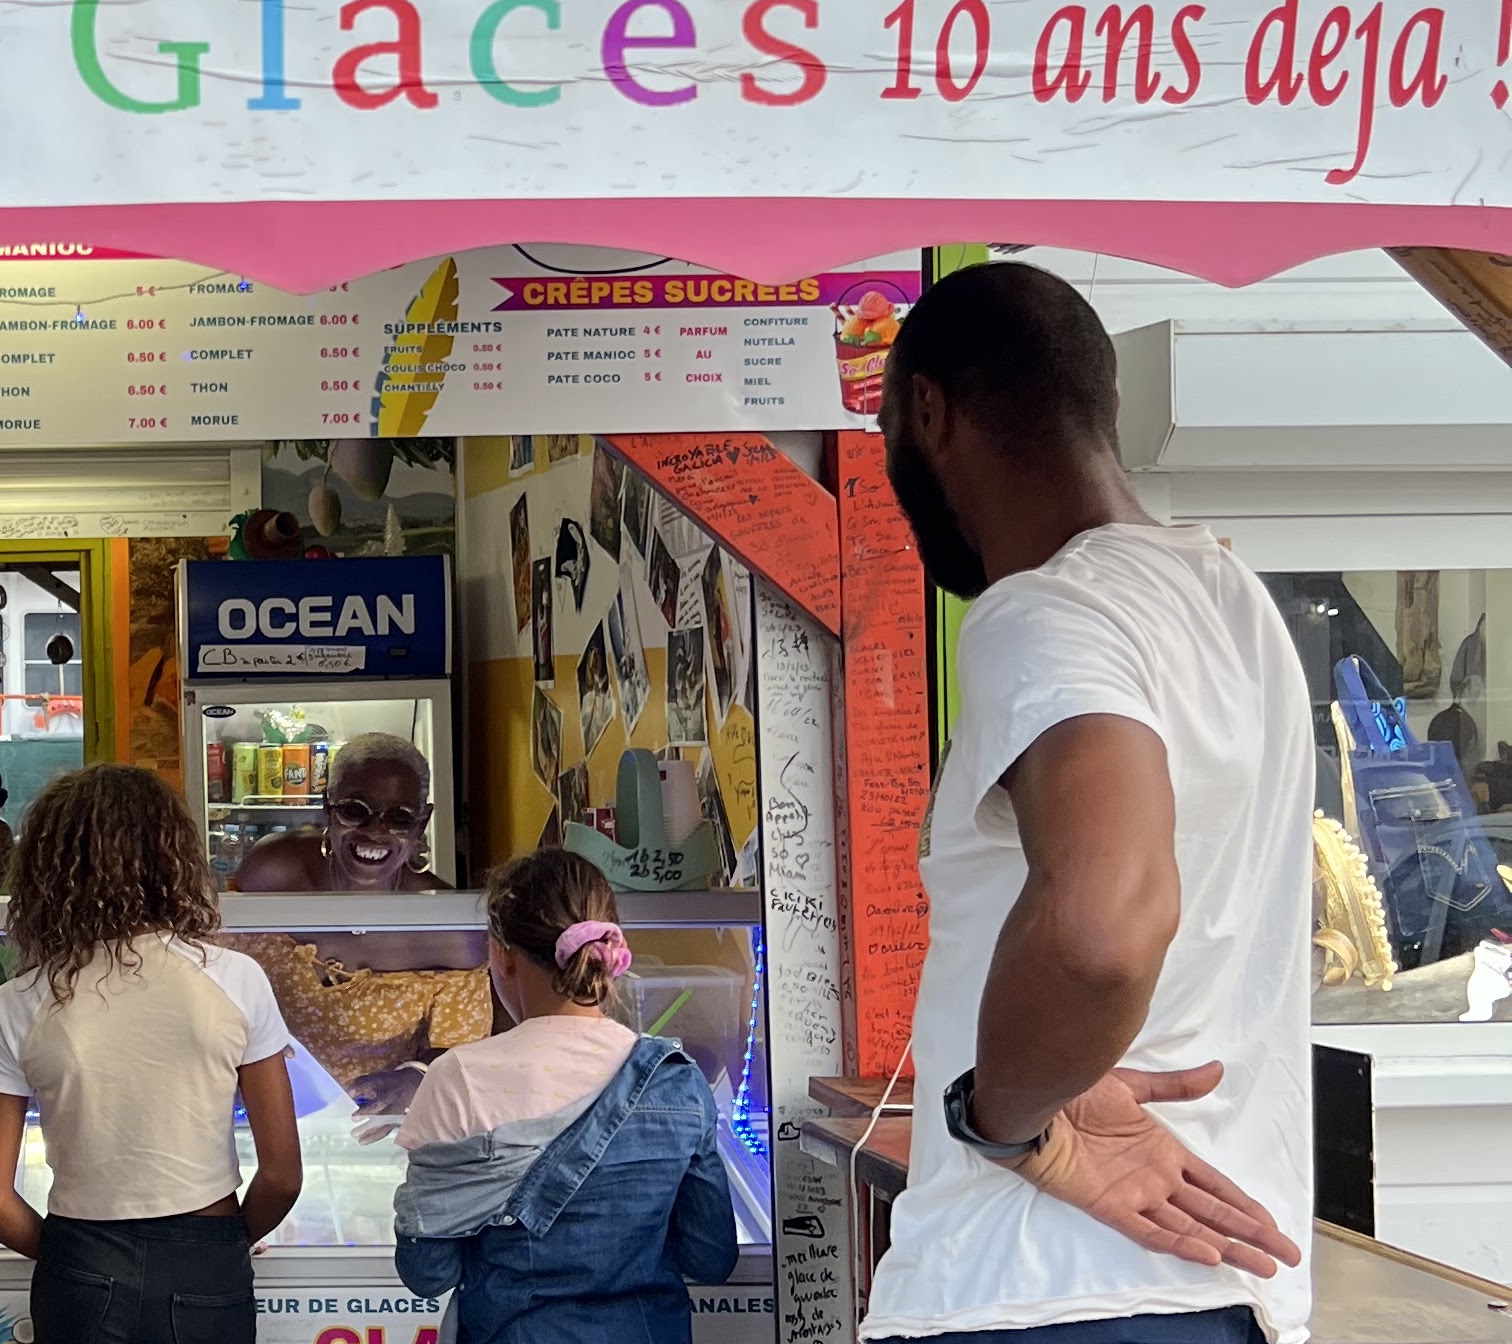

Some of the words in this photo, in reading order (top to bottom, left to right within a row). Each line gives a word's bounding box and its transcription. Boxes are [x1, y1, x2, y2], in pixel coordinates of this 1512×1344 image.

[1032, 4, 1206, 104] ans
[524, 277, 653, 305] CRÊPES
[744, 318, 808, 326] CONFITURE
[547, 328, 578, 337] PATE
[584, 328, 635, 337] NATURE
[643, 326, 650, 335] 4
[680, 327, 727, 336] PARFUM
[744, 338, 795, 346] NUTELLA
[473, 344, 493, 352] 0.50
[548, 352, 579, 360] PATE
[584, 351, 635, 360] MANIOC
[644, 349, 650, 358] 5
[696, 350, 711, 359] AU
[744, 358, 781, 366] SUCRE
[385, 364, 424, 372] COULIS
[428, 364, 466, 372] CHOCO
[473, 363, 493, 371] 0.50
[548, 375, 579, 383] PATE
[584, 374, 620, 383] COCO
[645, 373, 651, 381] 5
[686, 374, 722, 382] CHOIX
[474, 382, 494, 390] 0.50
[745, 397, 784, 405] FRUITS
[129, 418, 155, 428] 7.00
[192, 416, 238, 425] MORUE
[322, 414, 348, 423] 7.00
[218, 594, 414, 639] OCEAN
[309, 1299, 338, 1313] DE
[347, 1295, 440, 1313] GLACES
